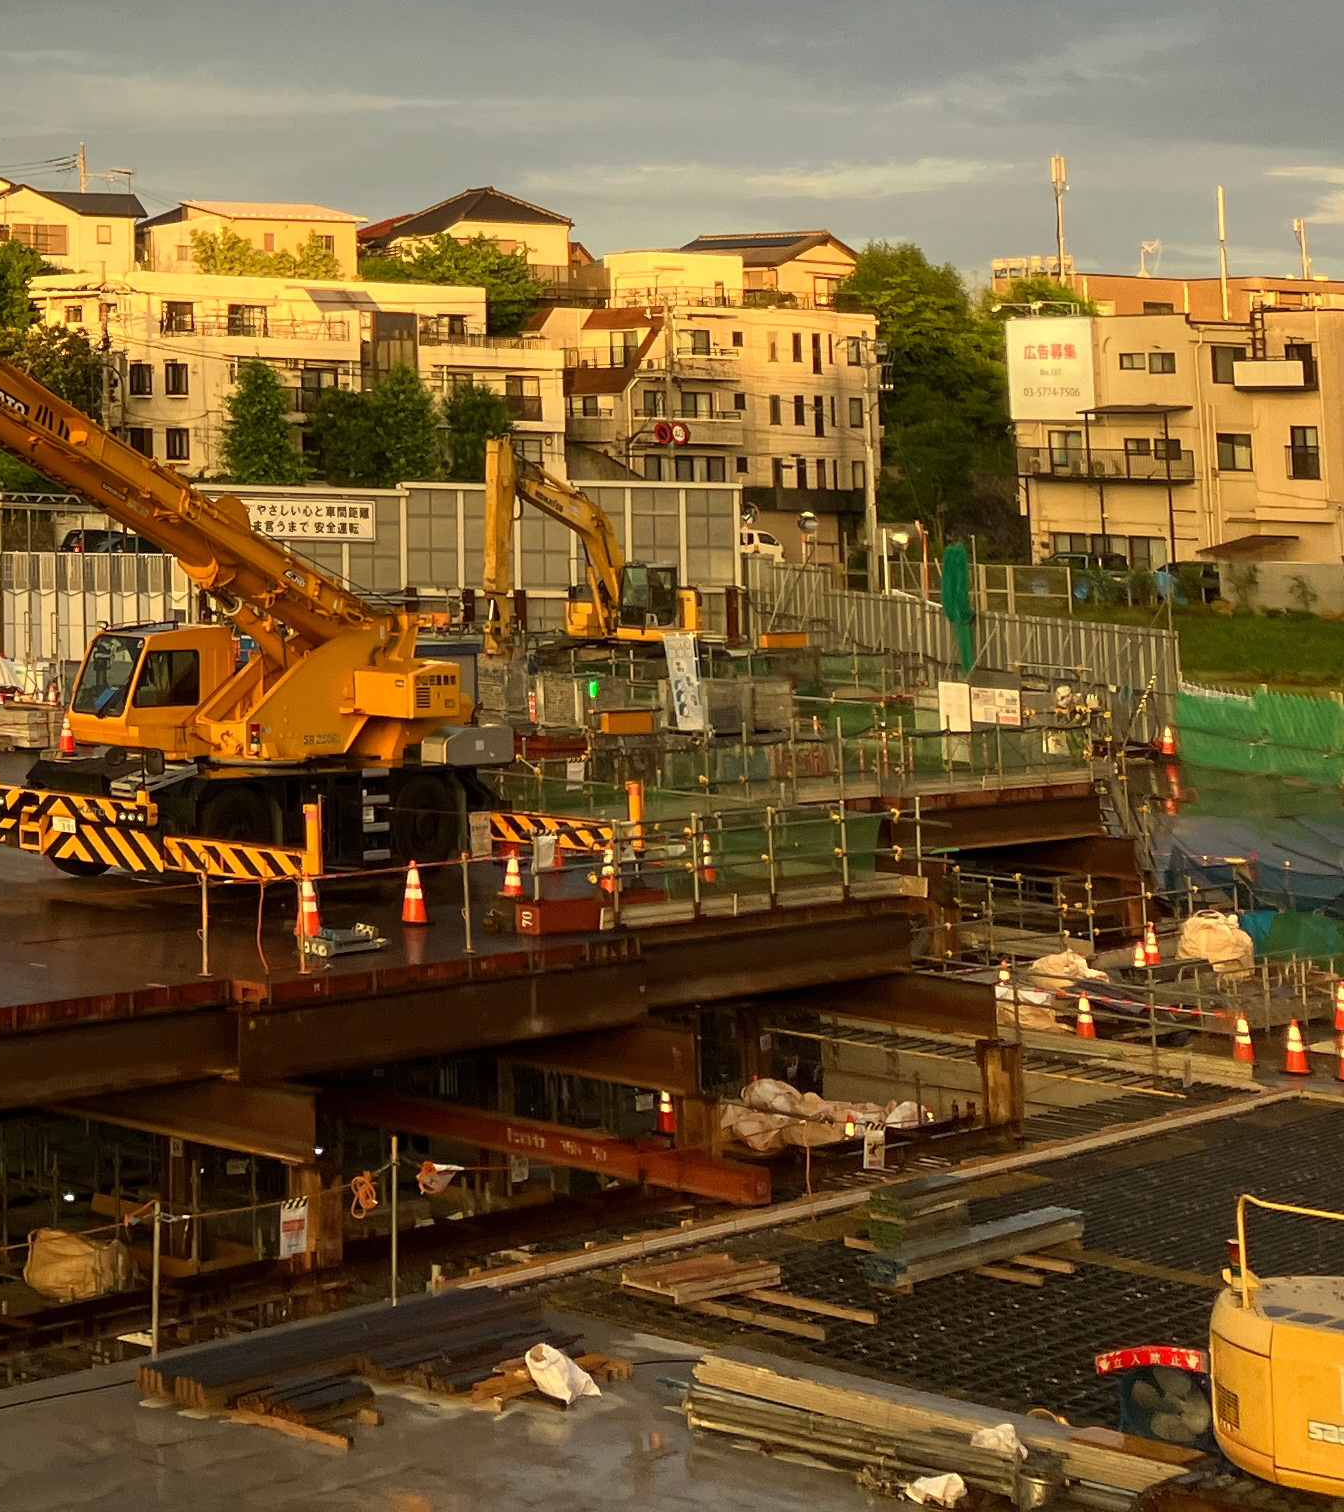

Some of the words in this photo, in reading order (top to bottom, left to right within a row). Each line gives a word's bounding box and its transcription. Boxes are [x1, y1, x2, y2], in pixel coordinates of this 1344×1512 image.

[1023, 343, 1077, 360] 広告募集
[1023, 387, 1081, 397] 03-5774-7506
[256, 505, 370, 519] やさしい心と車間距離
[314, 522, 360, 534] 安全運転
[521, 910, 533, 928] 70
[1113, 1352, 1182, 1369] 立入禁止
